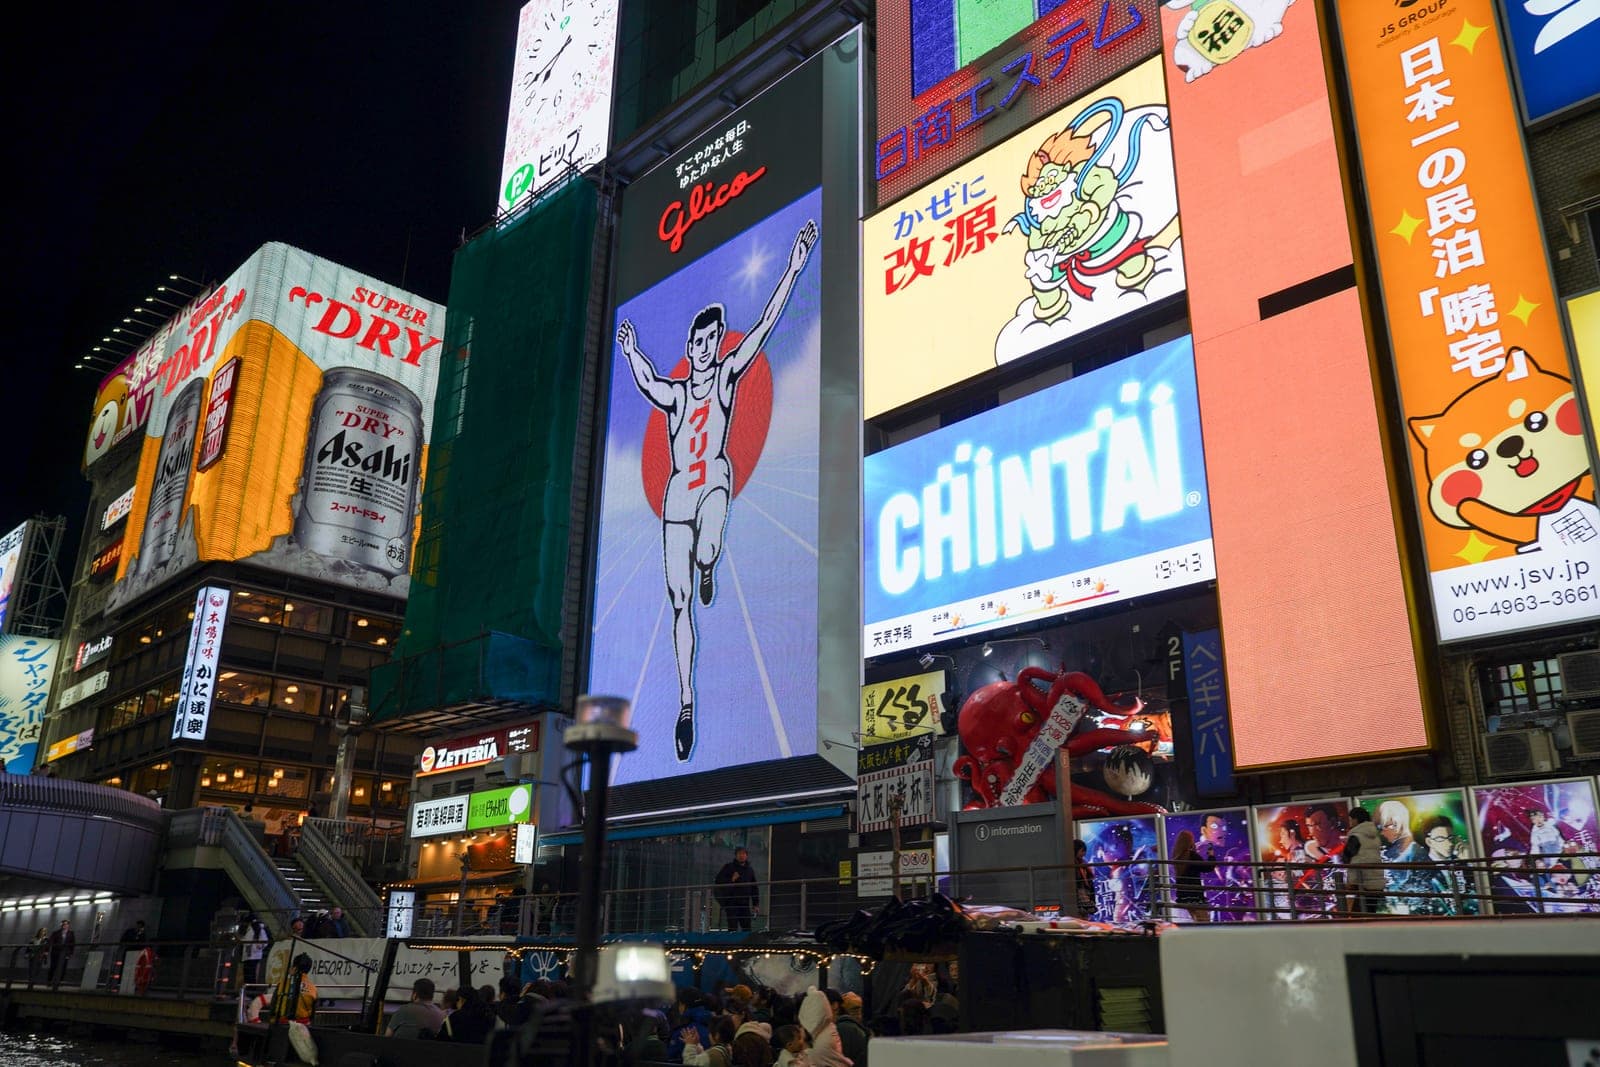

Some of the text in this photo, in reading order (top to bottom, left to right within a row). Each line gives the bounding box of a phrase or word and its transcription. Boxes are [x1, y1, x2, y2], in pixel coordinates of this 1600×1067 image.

[1398, 0, 1448, 28] GROUP
[679, 139, 744, 189] ゆたかな人生
[893, 174, 987, 240] かぜに
[883, 194, 1000, 296] 改源
[351, 284, 428, 328] SUPER
[355, 405, 390, 420] SUPER
[317, 428, 411, 486] Asahi
[688, 398, 713, 492] グリコ
[349, 476, 374, 497] 生
[330, 501, 387, 524] スーパードライ
[1155, 552, 1202, 580] 19:43
[1450, 557, 1591, 598] www.jsv.jp
[1453, 583, 1599, 624] 06-4963-3661
[873, 624, 913, 648] 天気予報
[876, 684, 929, 731] くくる
[1190, 641, 1227, 779] ペンギンバー
[435, 742, 498, 769] ZETTERIA
[990, 821, 1042, 837] information
[312, 959, 352, 976] RESORTS
